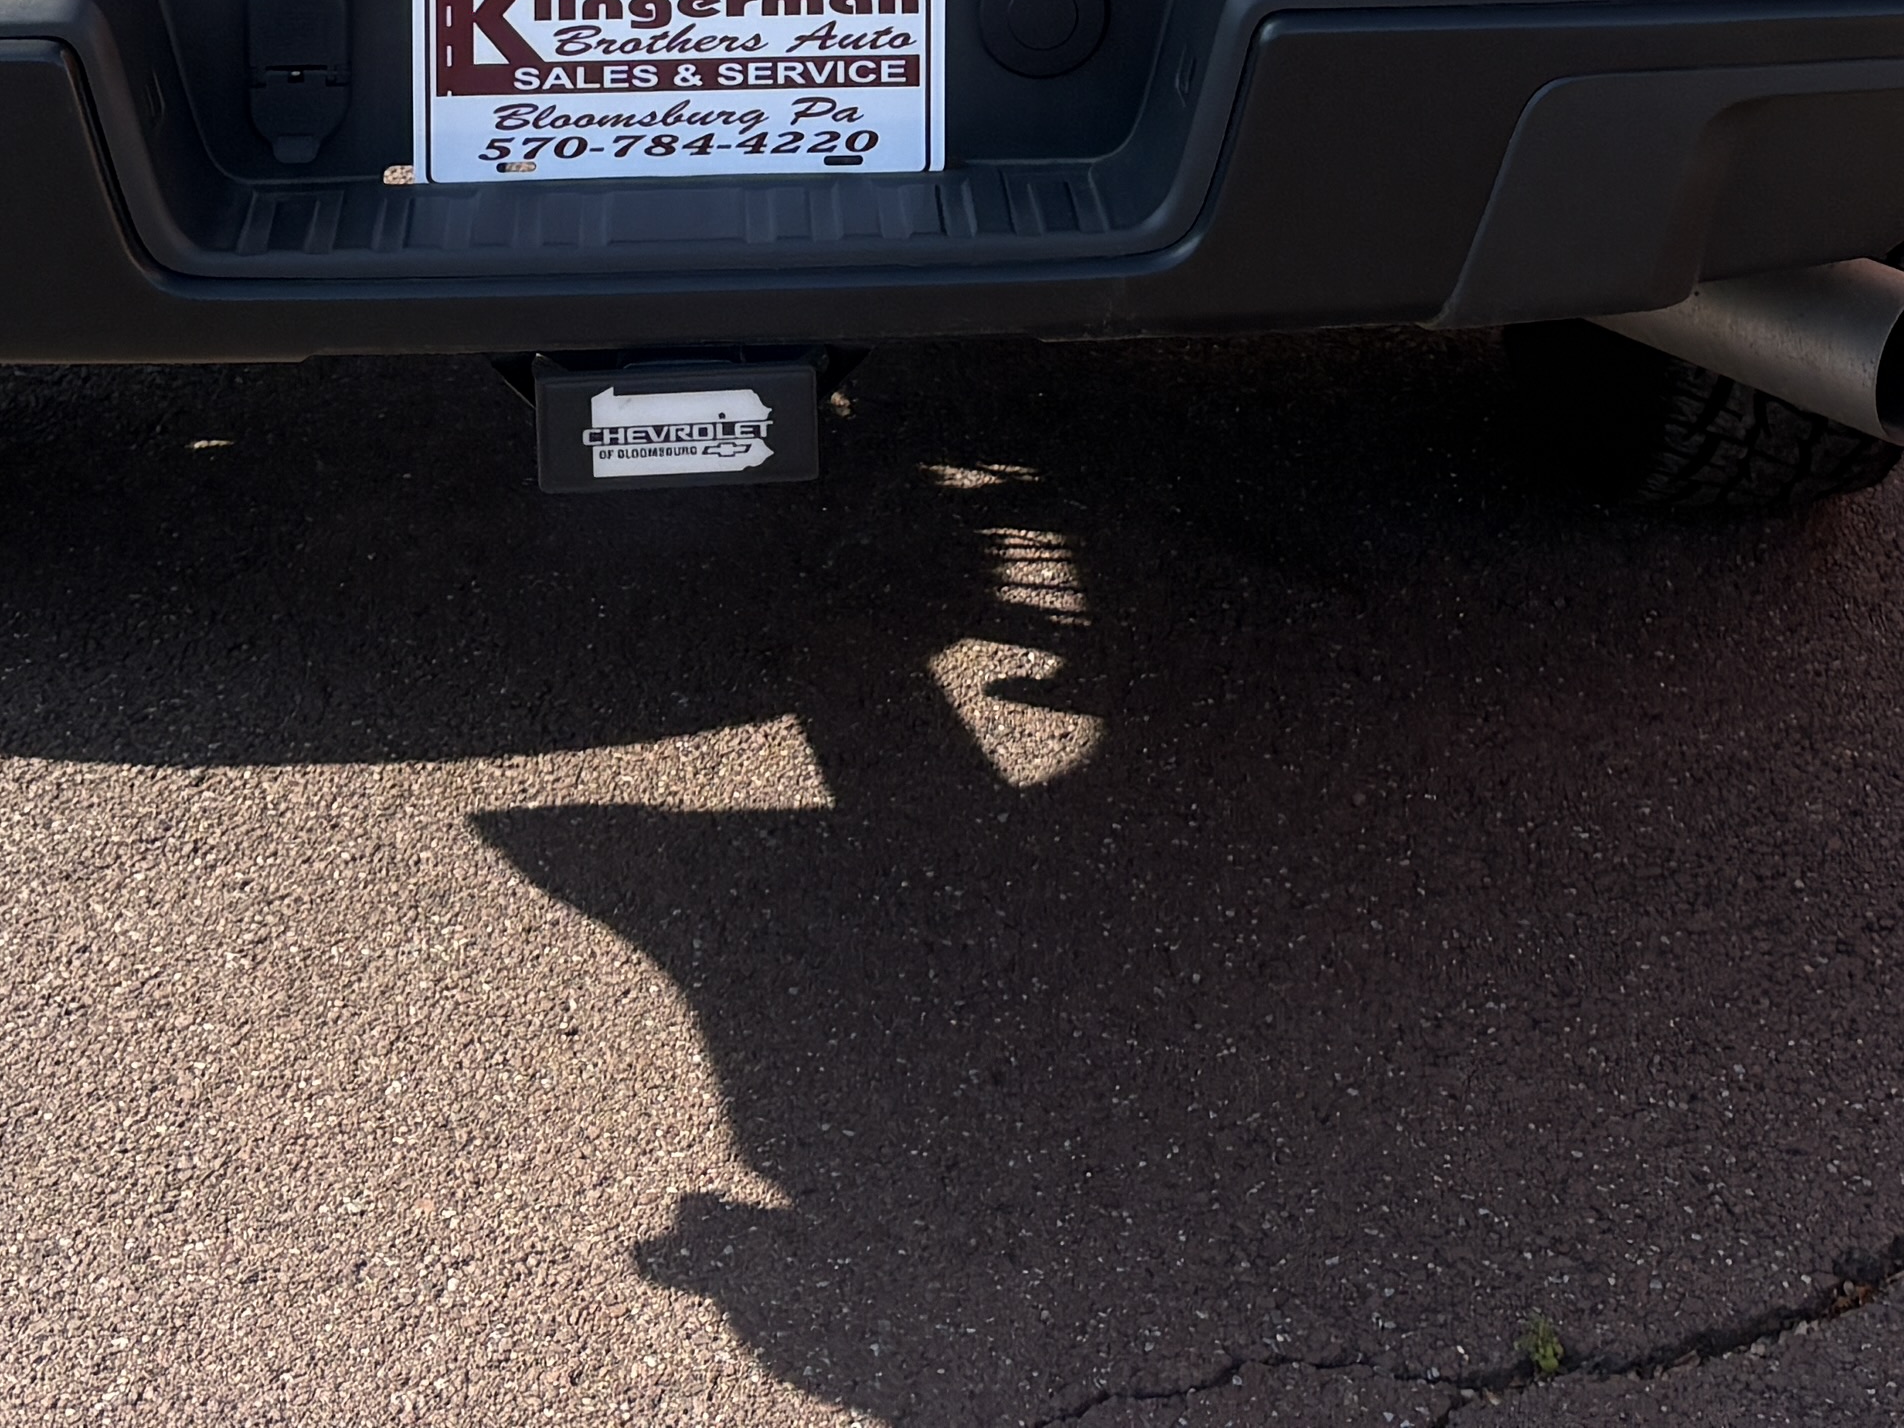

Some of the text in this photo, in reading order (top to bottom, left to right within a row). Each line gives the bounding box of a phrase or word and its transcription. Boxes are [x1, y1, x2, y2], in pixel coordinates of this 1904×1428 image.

[553, 19, 918, 57] Brothers Auto
[513, 59, 907, 91] SALES & SERVICE
[493, 96, 865, 134] Bloomsburg Pa
[477, 128, 879, 162] 570-784-4220
[582, 420, 774, 447] CHEVROLET
